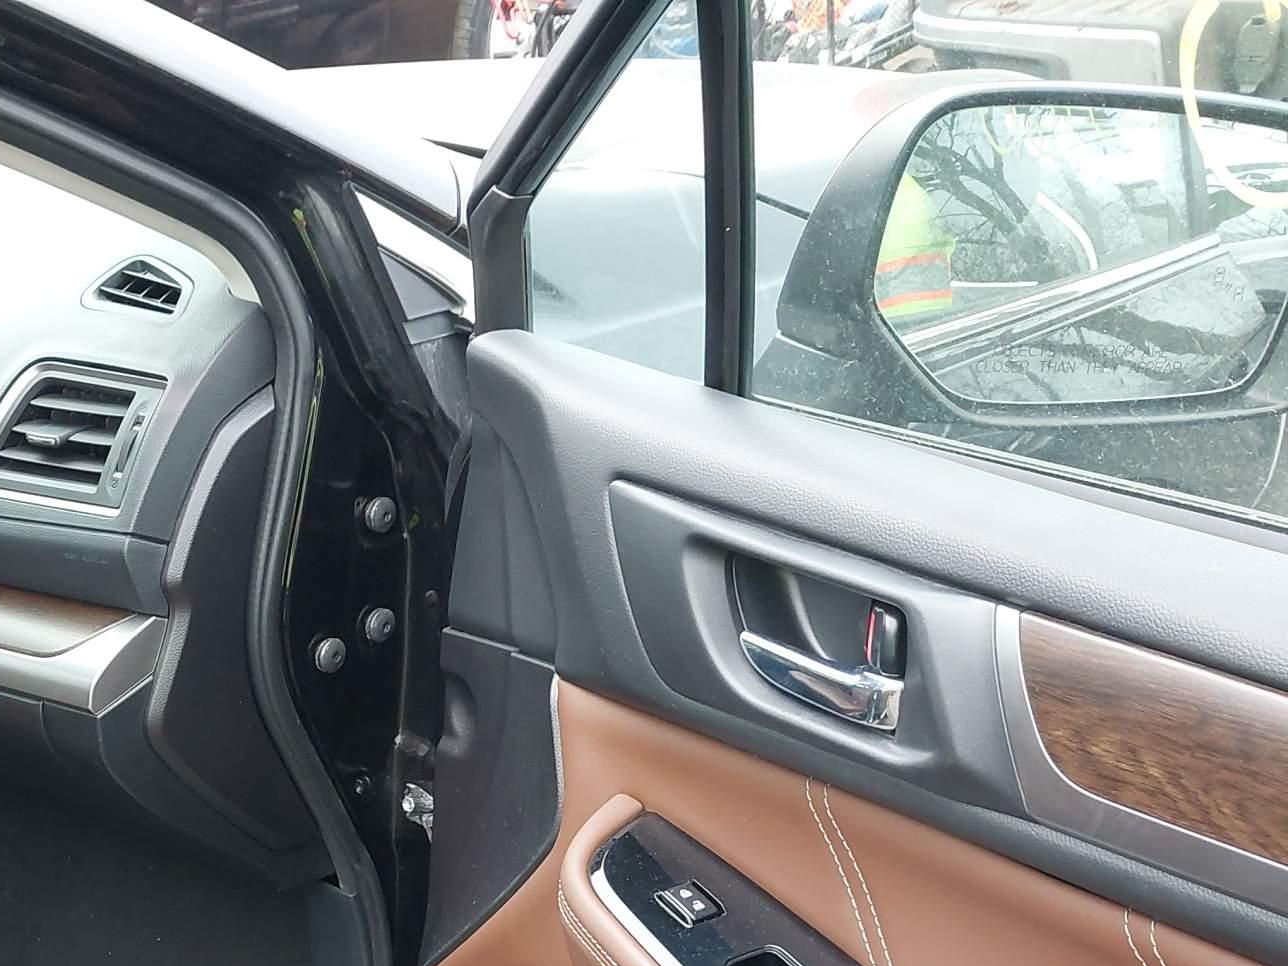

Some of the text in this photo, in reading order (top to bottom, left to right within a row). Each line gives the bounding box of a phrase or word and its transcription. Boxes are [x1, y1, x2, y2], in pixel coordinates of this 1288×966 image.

[976, 360, 1183, 375] CLOSER THAN THEY APPEAR
